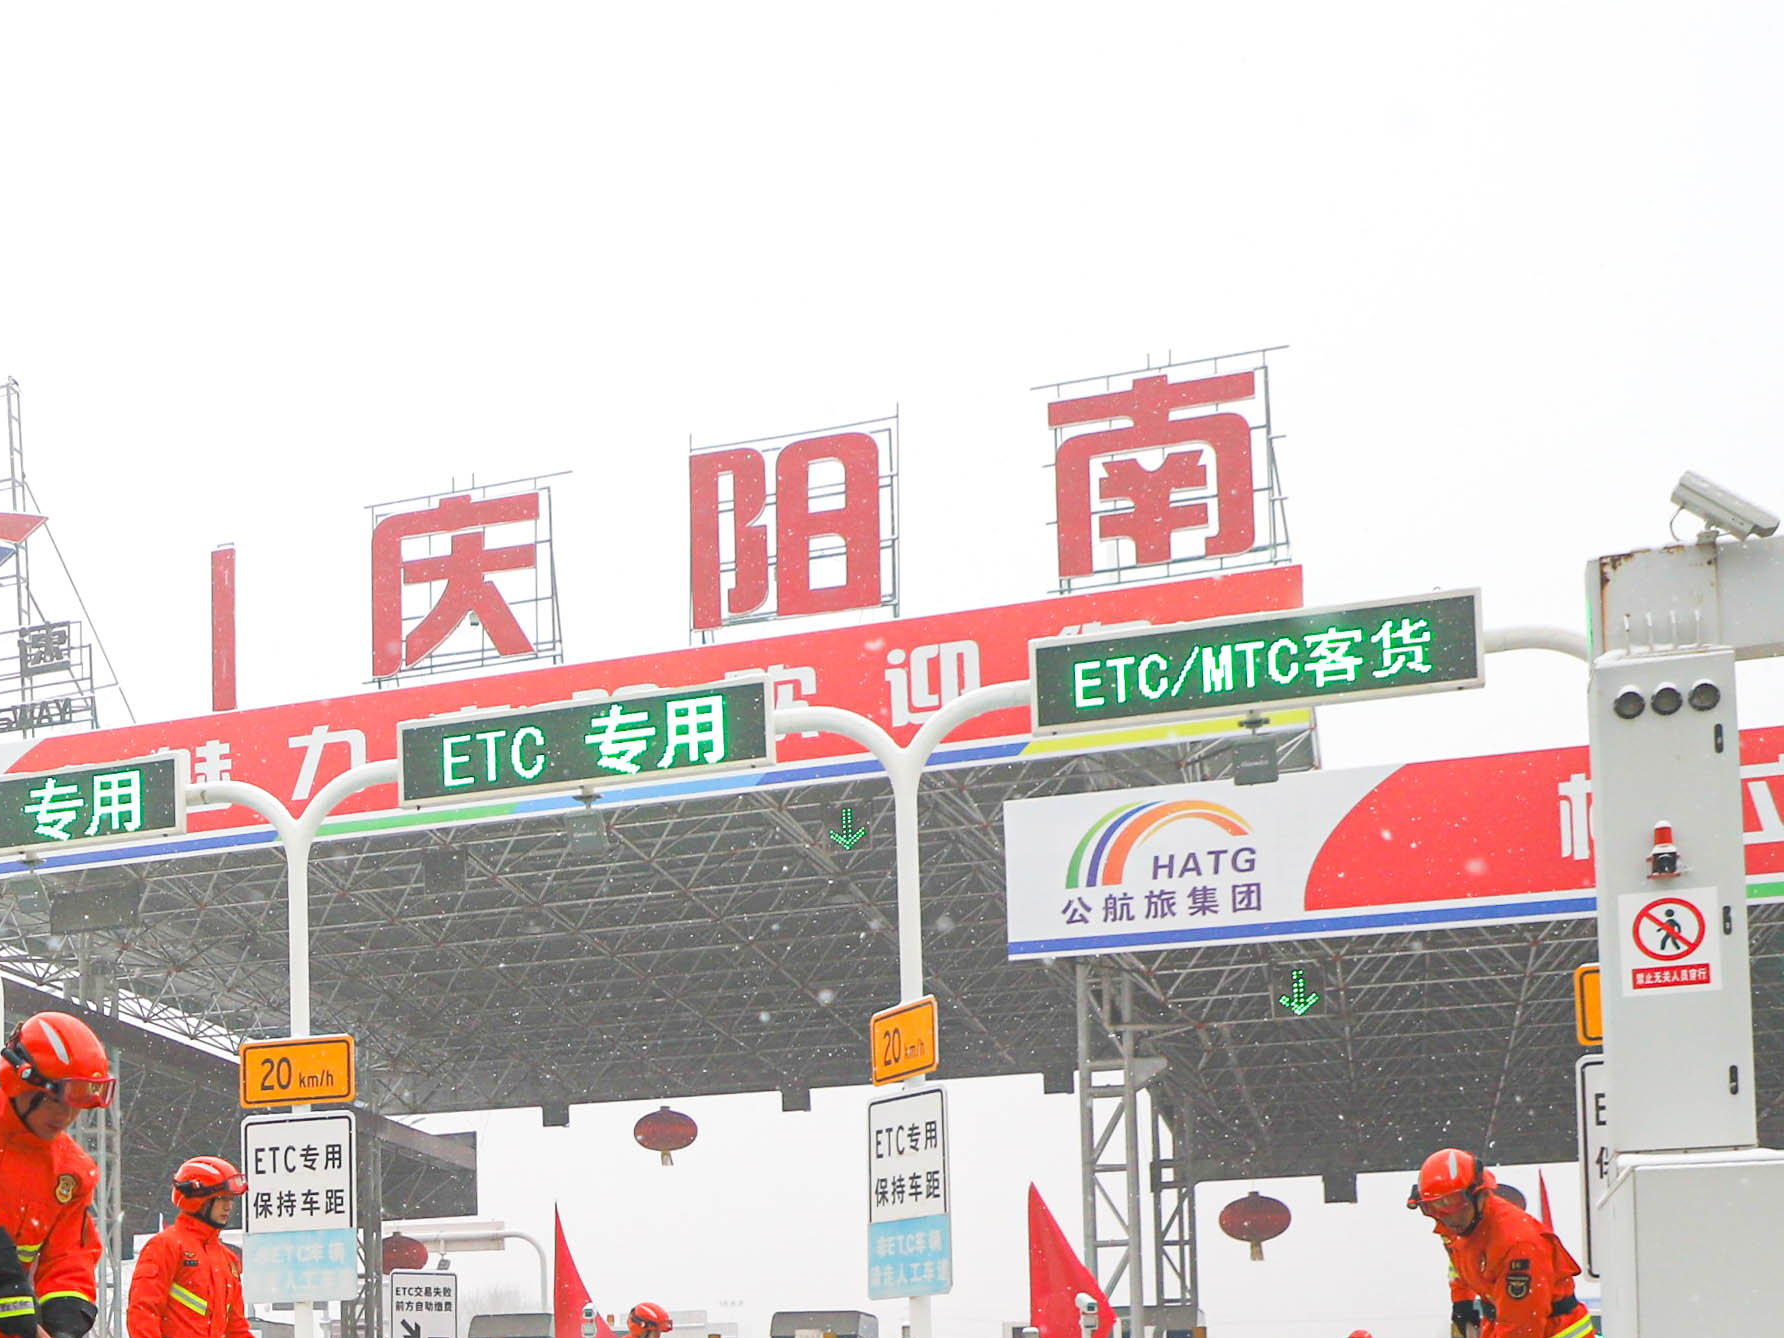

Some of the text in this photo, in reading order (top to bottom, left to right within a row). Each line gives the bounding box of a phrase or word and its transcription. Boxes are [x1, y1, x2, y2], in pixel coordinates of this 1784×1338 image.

[373, 372, 1255, 679] 庆阳南
[1074, 618, 1432, 708] ETC/MTC客货
[441, 694, 727, 788] ETC 专用
[23, 769, 142, 841] 专用
[1152, 847, 1257, 880] HATG
[1061, 882, 1262, 925] 公航旅集团
[883, 1027, 901, 1067] 20
[260, 1056, 334, 1092] 20 km/h
[254, 1143, 343, 1175] ETC专用
[875, 1119, 938, 1159] ETC专用
[253, 1188, 346, 1219] 保持车距
[874, 1169, 941, 1208] 保持车距
